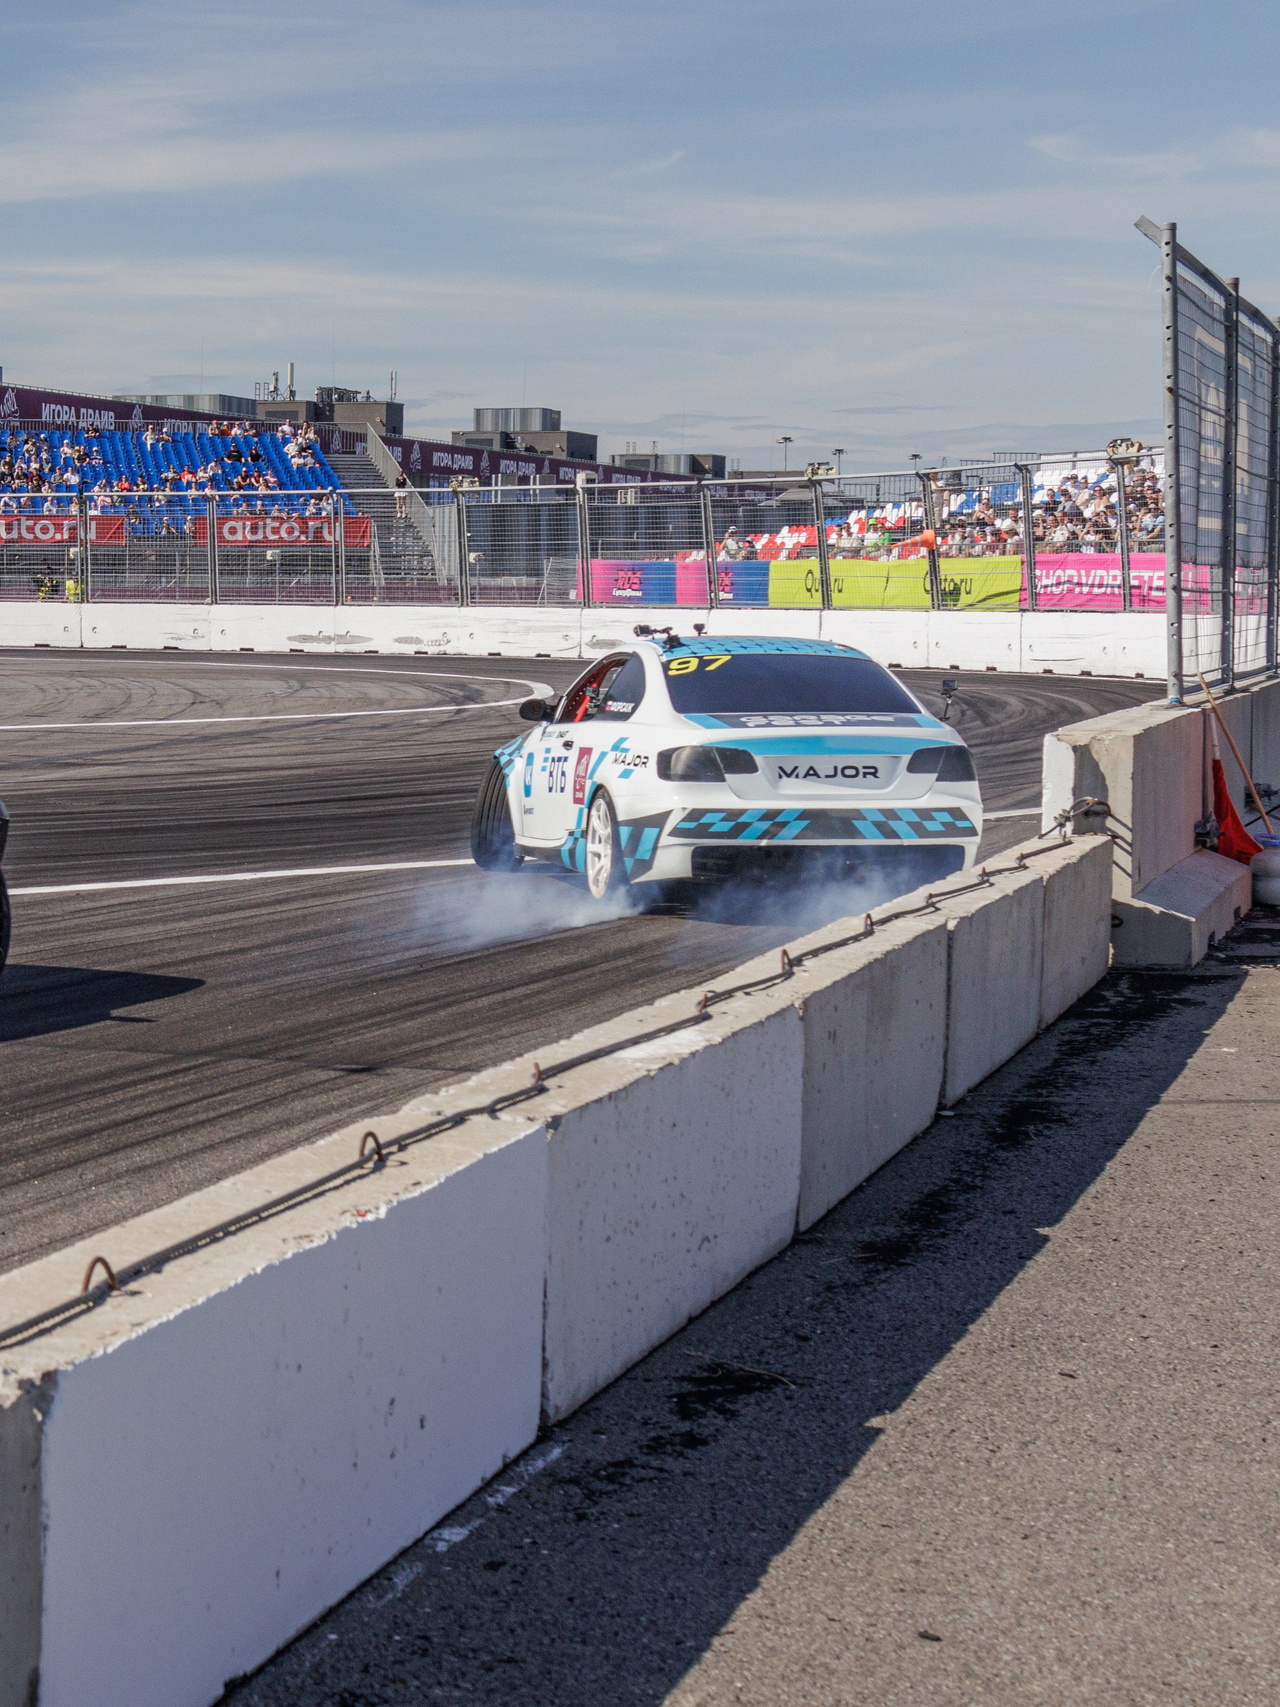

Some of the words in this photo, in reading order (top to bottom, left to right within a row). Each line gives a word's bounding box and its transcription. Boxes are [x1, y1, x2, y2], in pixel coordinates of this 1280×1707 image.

[432, 451, 453, 468] ИГОРА
[223, 518, 341, 541] auto.ru
[667, 655, 732, 676] 97
[612, 753, 649, 768] MAJOR
[548, 756, 569, 793] ВТБ
[778, 765, 880, 779] MAJOR
